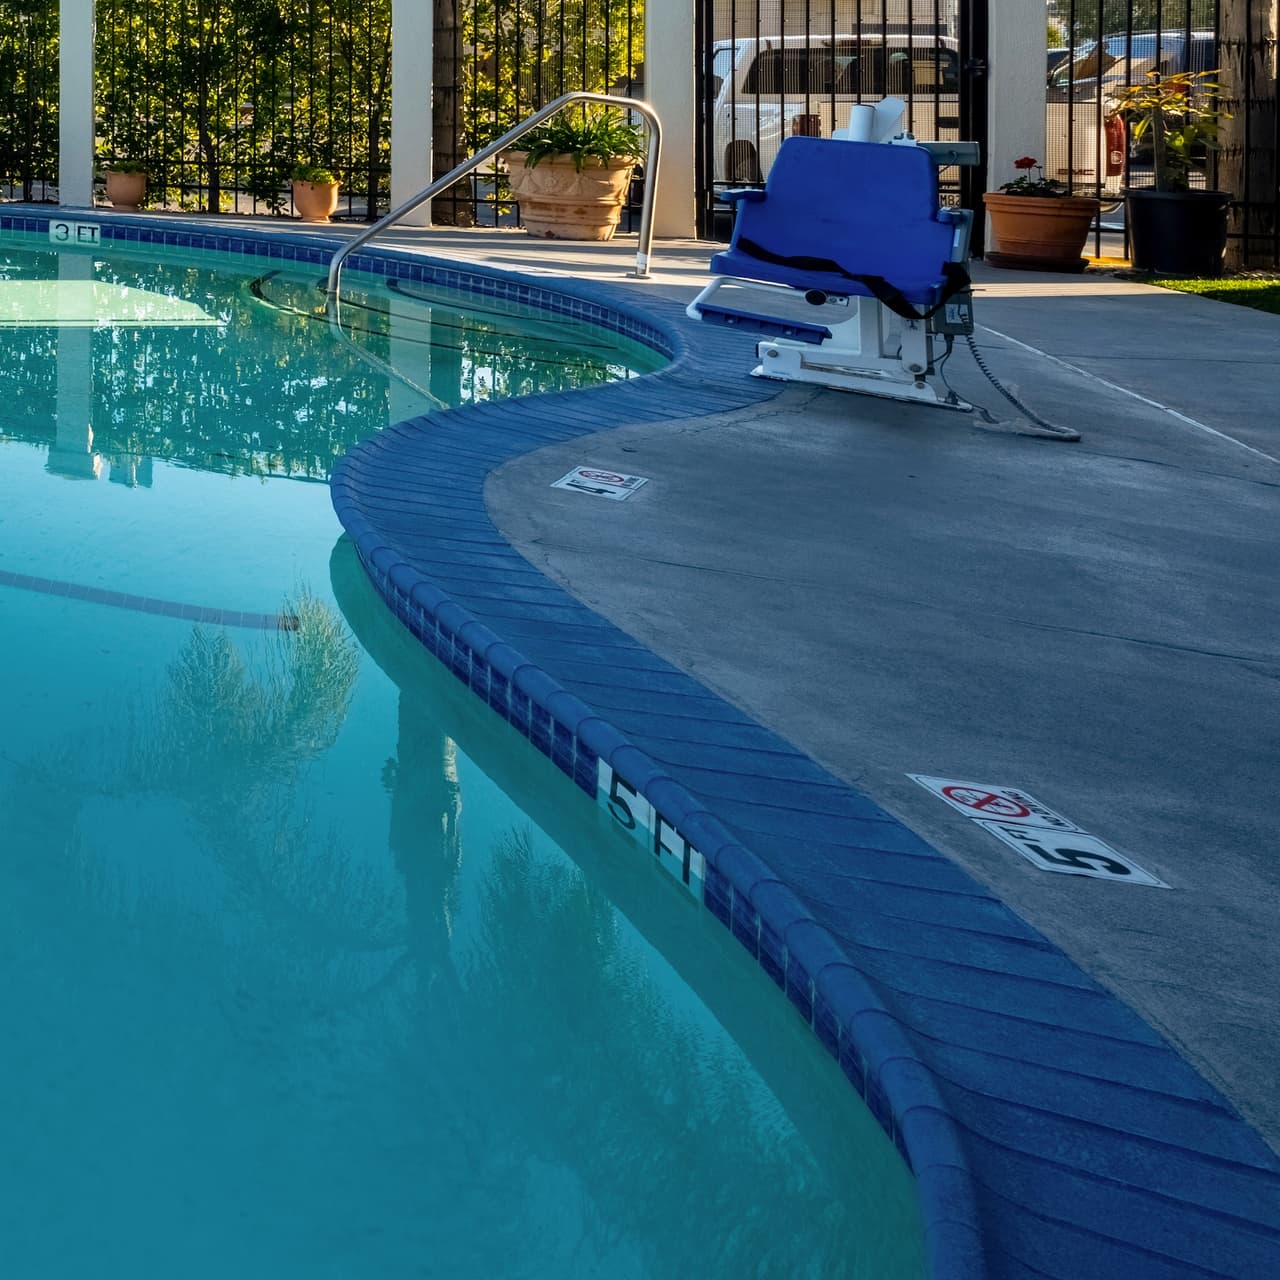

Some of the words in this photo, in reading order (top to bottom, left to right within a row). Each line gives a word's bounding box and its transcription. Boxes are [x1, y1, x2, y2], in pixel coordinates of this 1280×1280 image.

[607, 768, 637, 830] 5
[653, 810, 700, 887] FT
[998, 825, 1041, 842] FT
[1023, 843, 1132, 876] 5
